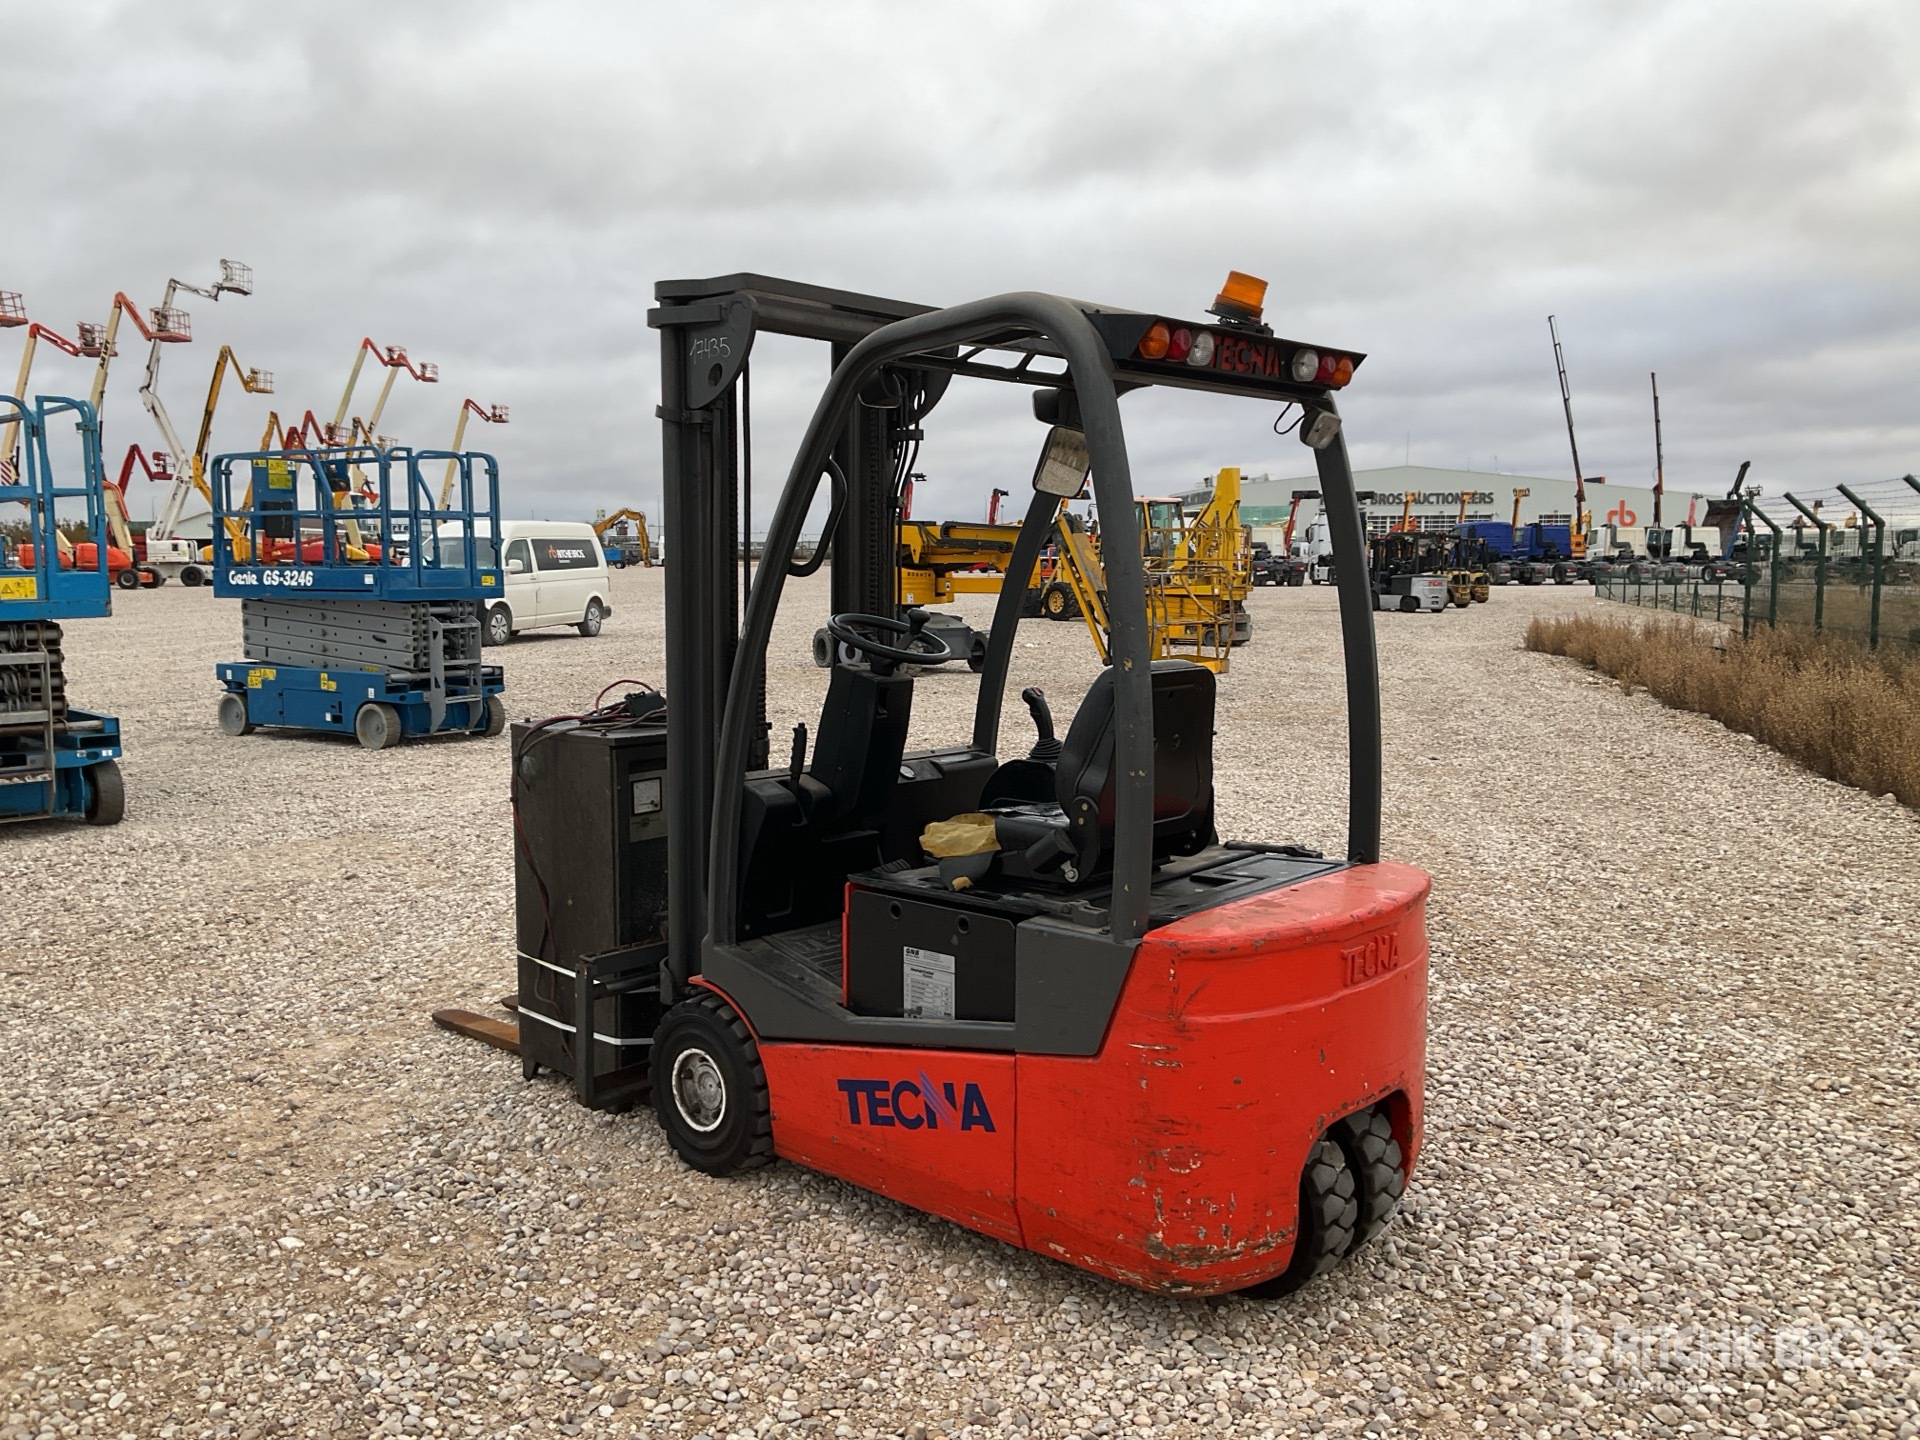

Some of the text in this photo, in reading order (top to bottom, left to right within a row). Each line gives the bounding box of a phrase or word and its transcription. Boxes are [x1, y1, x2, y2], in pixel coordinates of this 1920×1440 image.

[1210, 334, 1280, 378] TECNA
[1408, 491, 1494, 505] UCTIONERS
[1607, 499, 1637, 527] rb
[228, 569, 314, 587] Genie GS-3246
[1340, 930, 1398, 987] TECNA
[836, 1072, 997, 1133] TECNA
